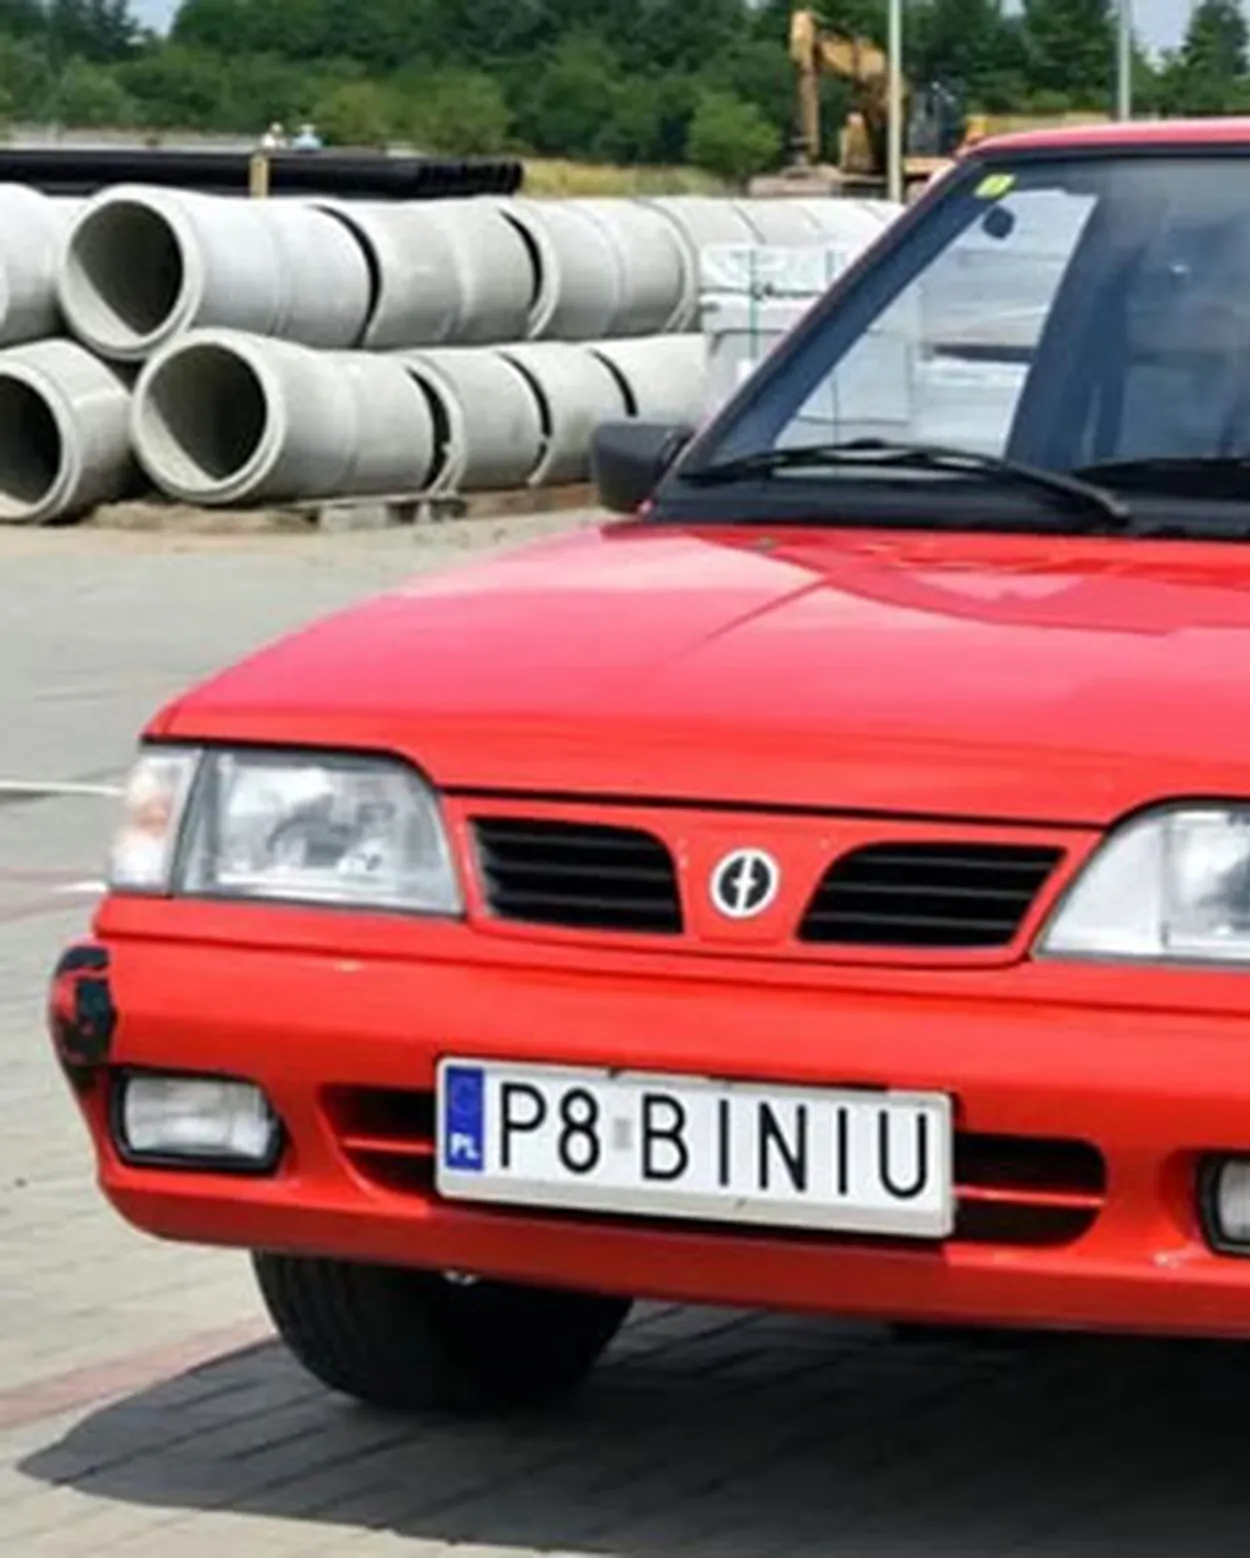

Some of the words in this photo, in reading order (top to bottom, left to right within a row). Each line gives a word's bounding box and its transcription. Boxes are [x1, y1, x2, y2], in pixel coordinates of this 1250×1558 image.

[450, 1133, 479, 1159] PL
[500, 1082, 600, 1173] P8
[643, 1095, 928, 1199] BINIU
